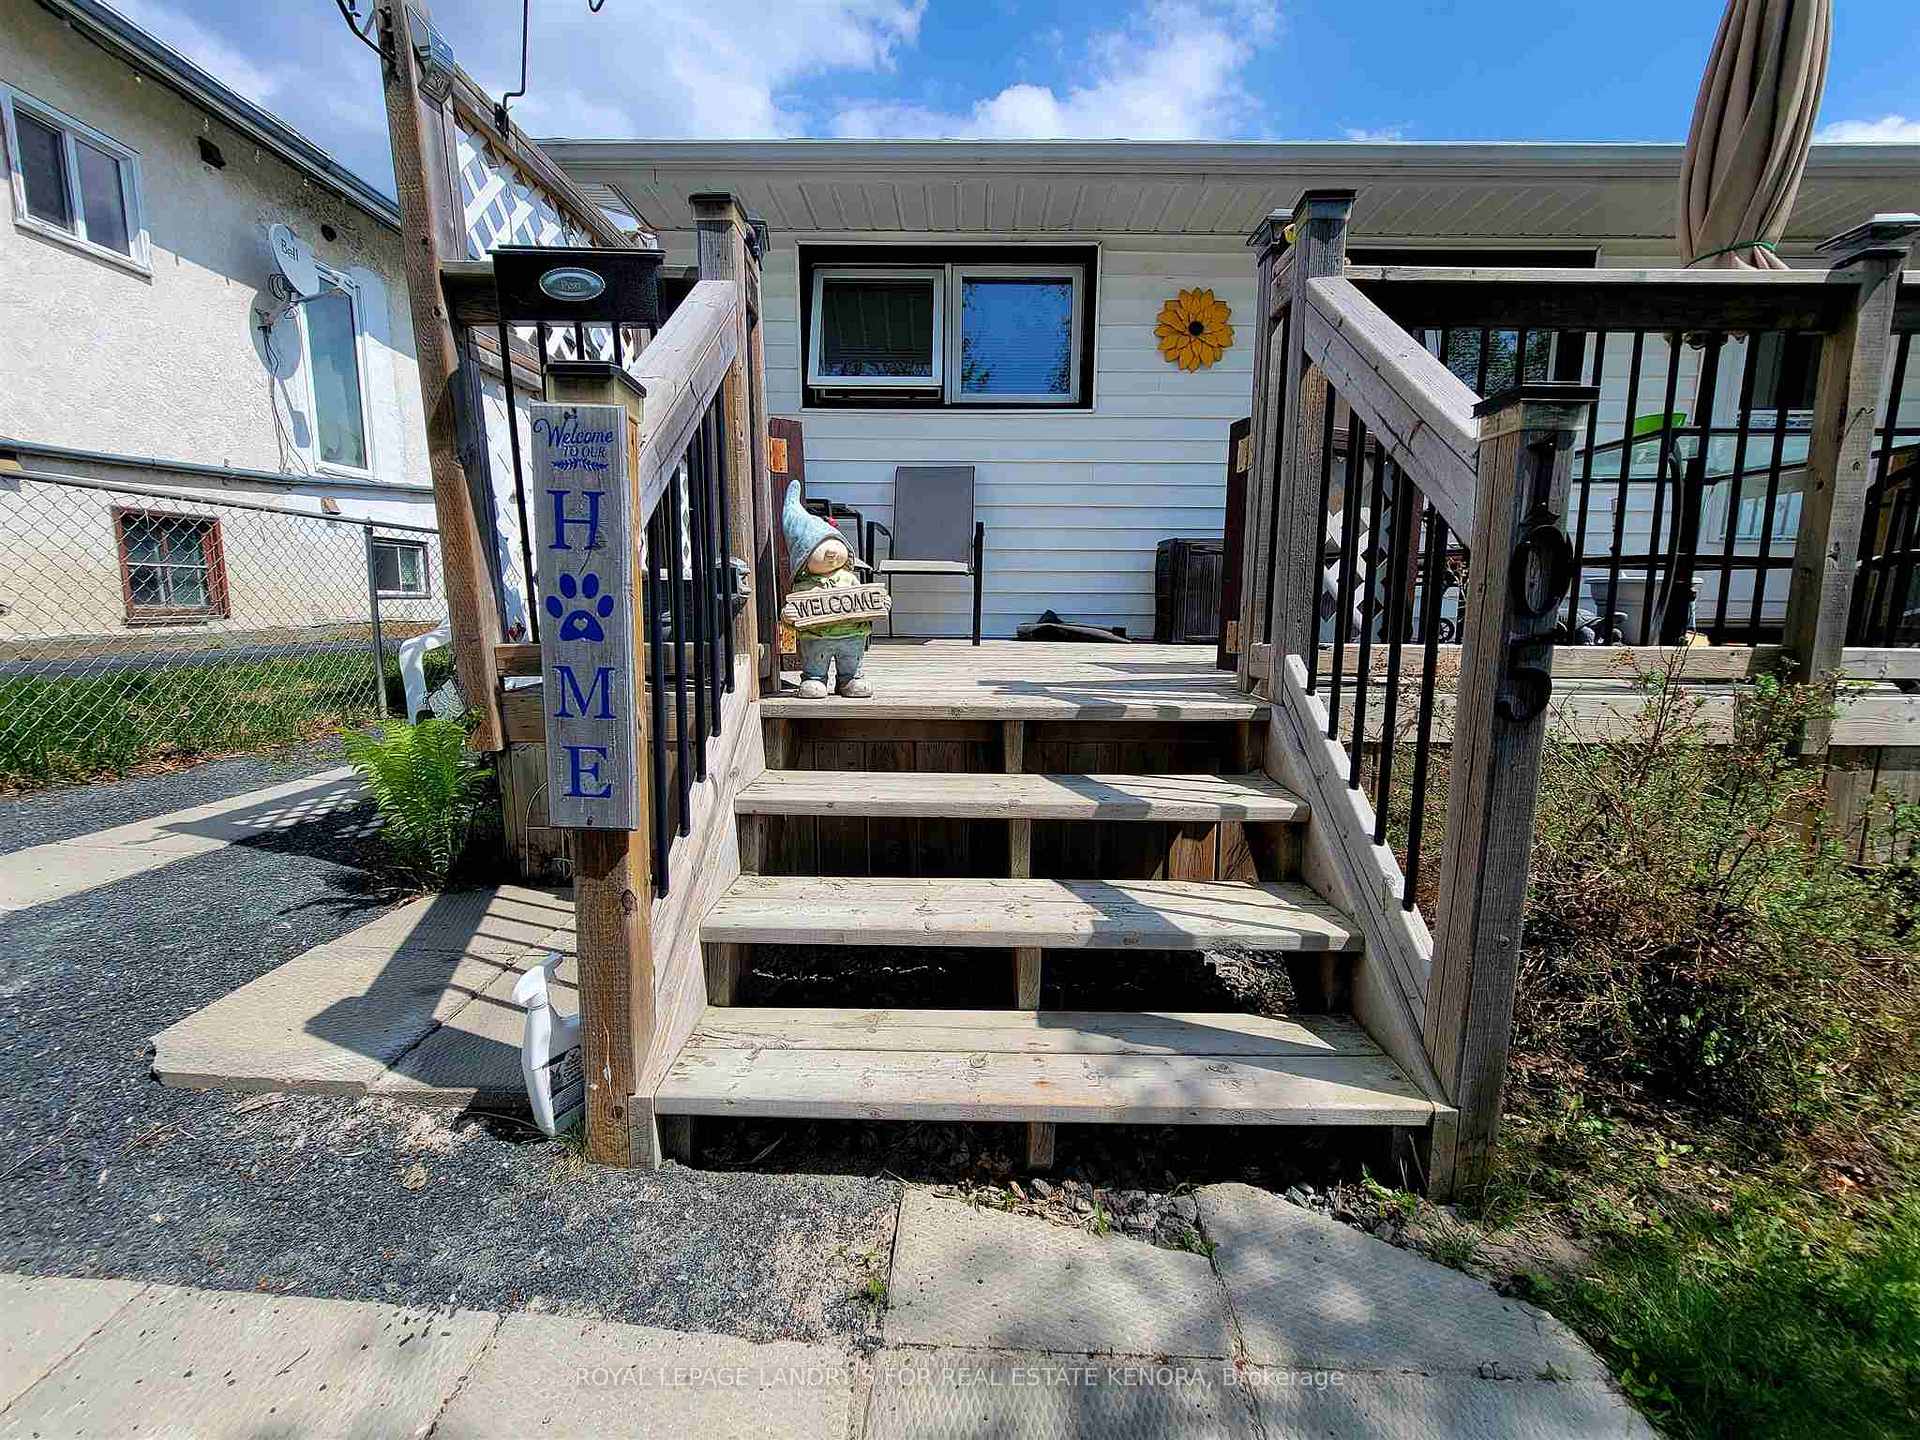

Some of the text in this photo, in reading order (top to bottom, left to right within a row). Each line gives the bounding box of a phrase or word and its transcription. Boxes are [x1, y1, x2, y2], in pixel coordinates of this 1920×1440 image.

[281, 239, 299, 262] Bell
[533, 417, 614, 447] Welcome
[563, 444, 607, 458] TO OUR
[792, 591, 882, 618] WELCOME
[546, 490, 616, 798] HME
